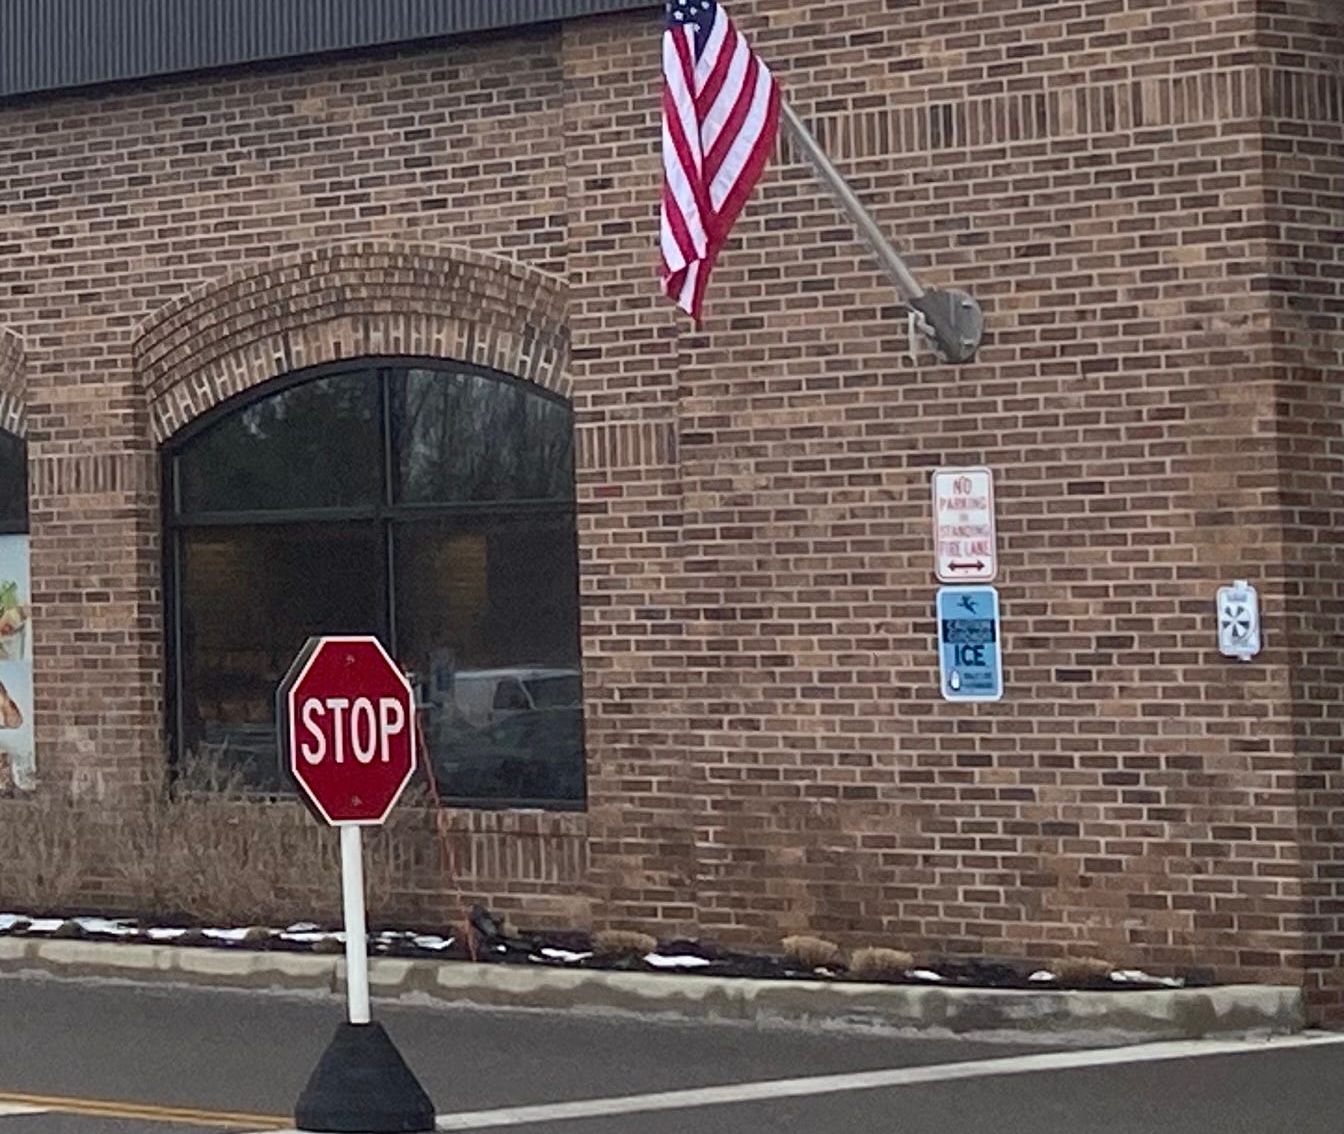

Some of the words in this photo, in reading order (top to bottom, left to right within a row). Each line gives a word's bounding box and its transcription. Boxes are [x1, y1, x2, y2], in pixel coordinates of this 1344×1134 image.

[952, 475, 973, 496] NO
[939, 495, 987, 511] PARKING
[939, 540, 962, 558] FIRE
[963, 540, 992, 558] LANE
[954, 644, 986, 667] ICE
[300, 696, 406, 766] STOP
